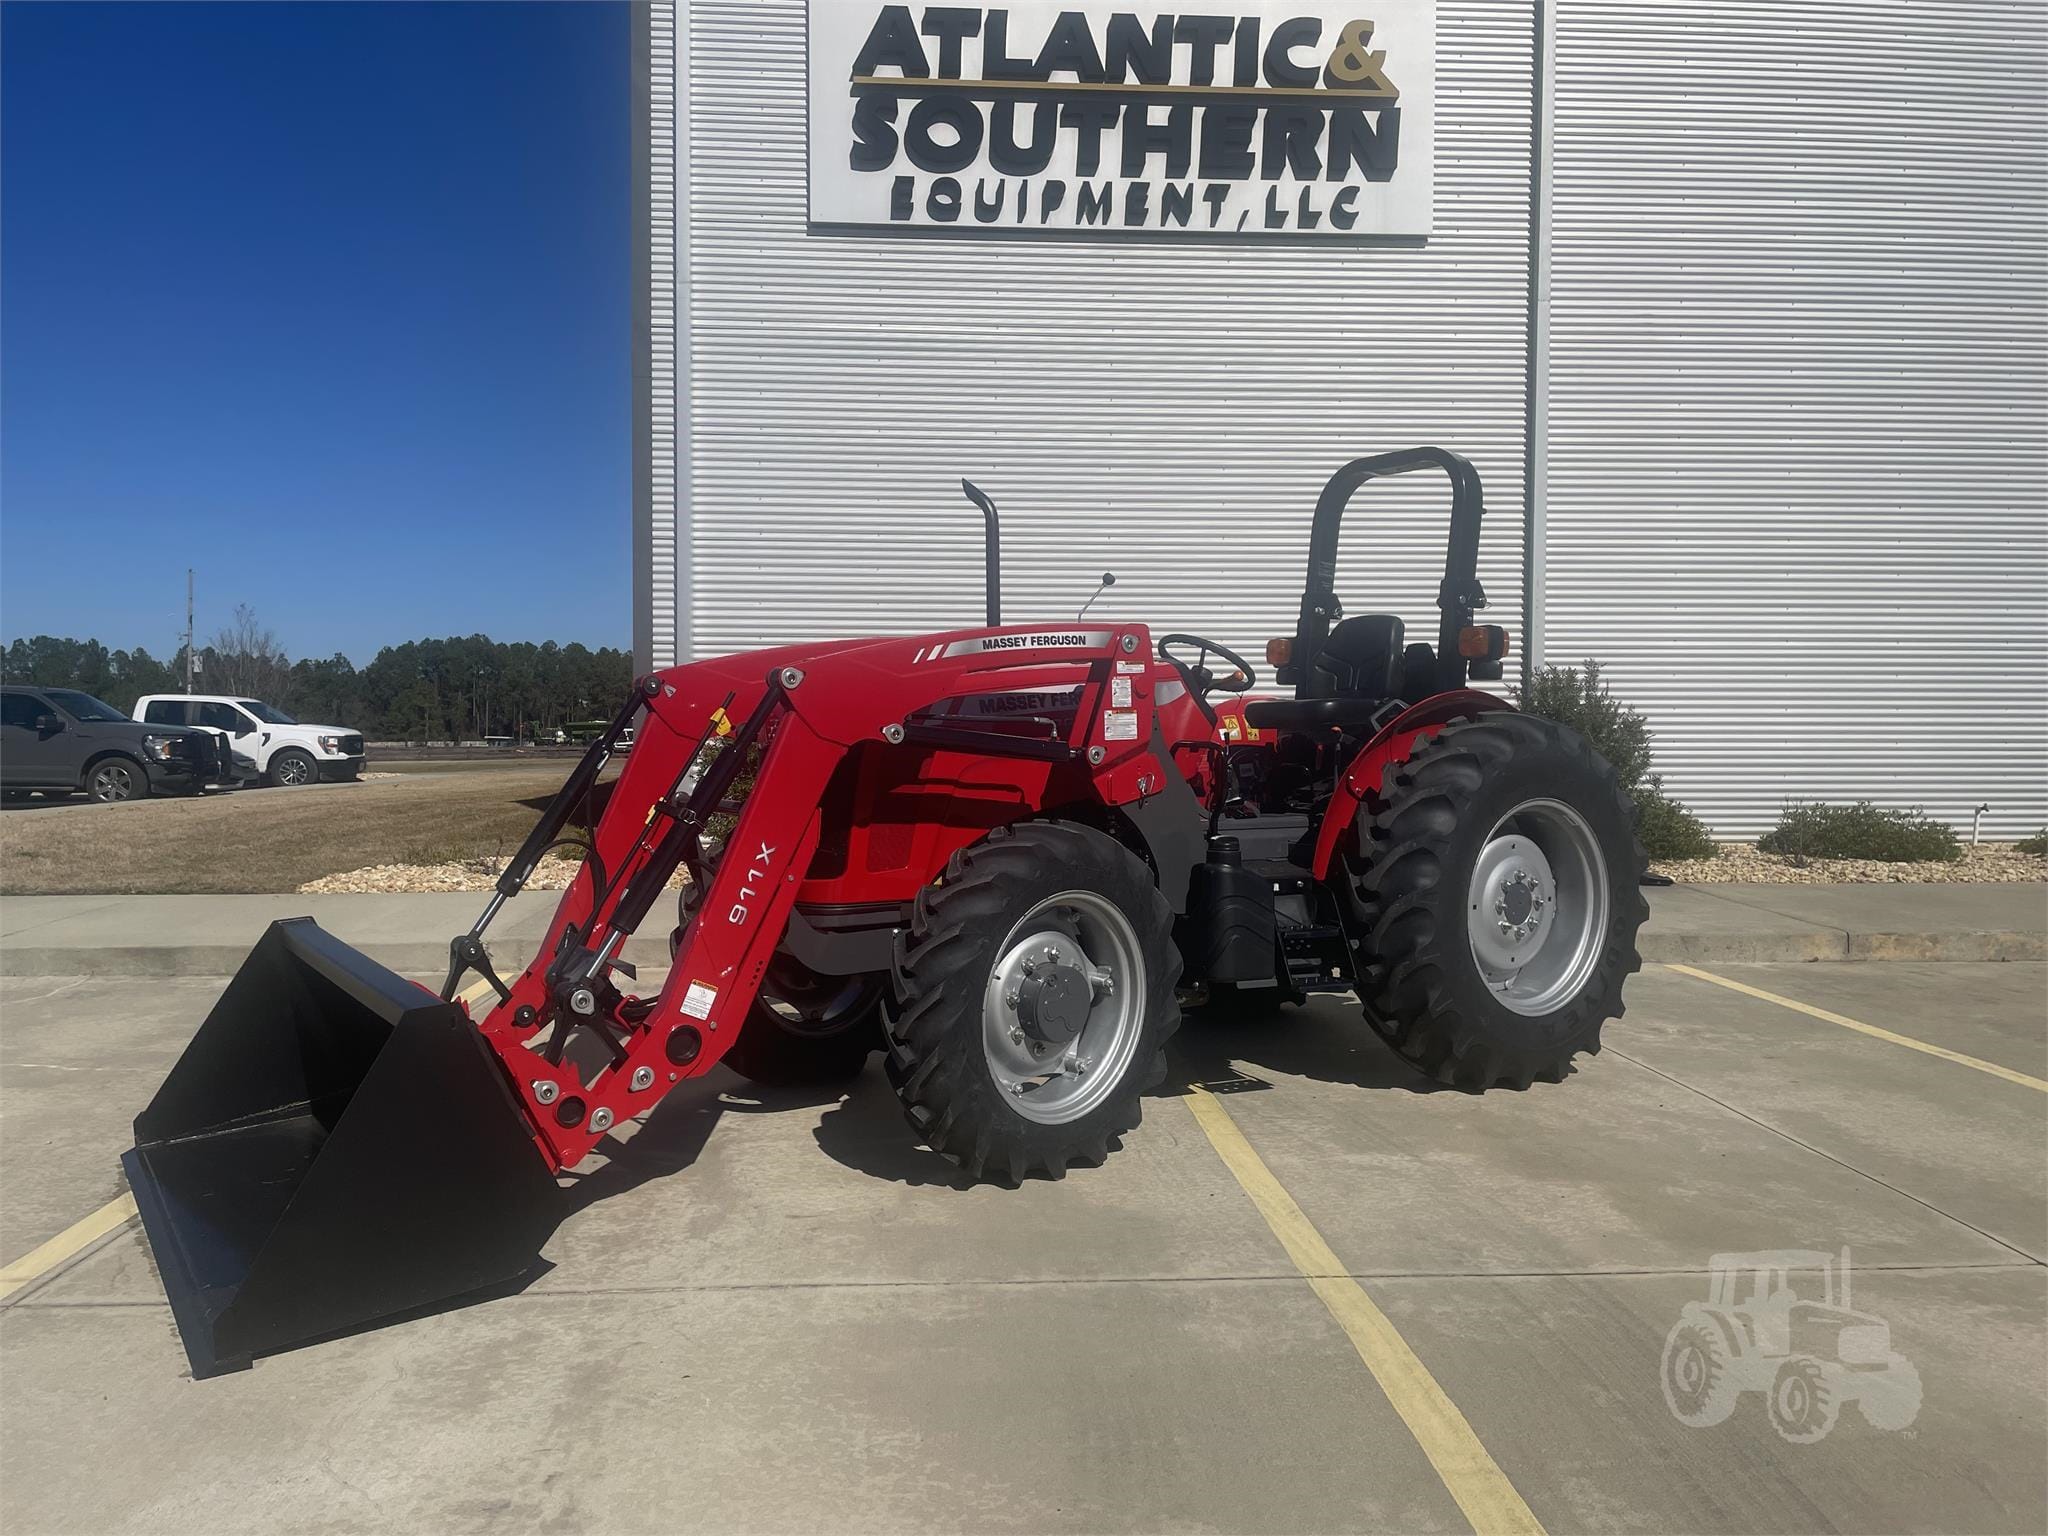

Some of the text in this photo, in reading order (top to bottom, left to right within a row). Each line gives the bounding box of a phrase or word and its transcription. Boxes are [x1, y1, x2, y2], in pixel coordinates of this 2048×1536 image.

[850, 93, 1401, 182] SOUTHERN
[982, 635, 1086, 650] MASSEY FERGUSON
[979, 693, 1045, 714] MASSEY
[729, 842, 776, 925] 911X
